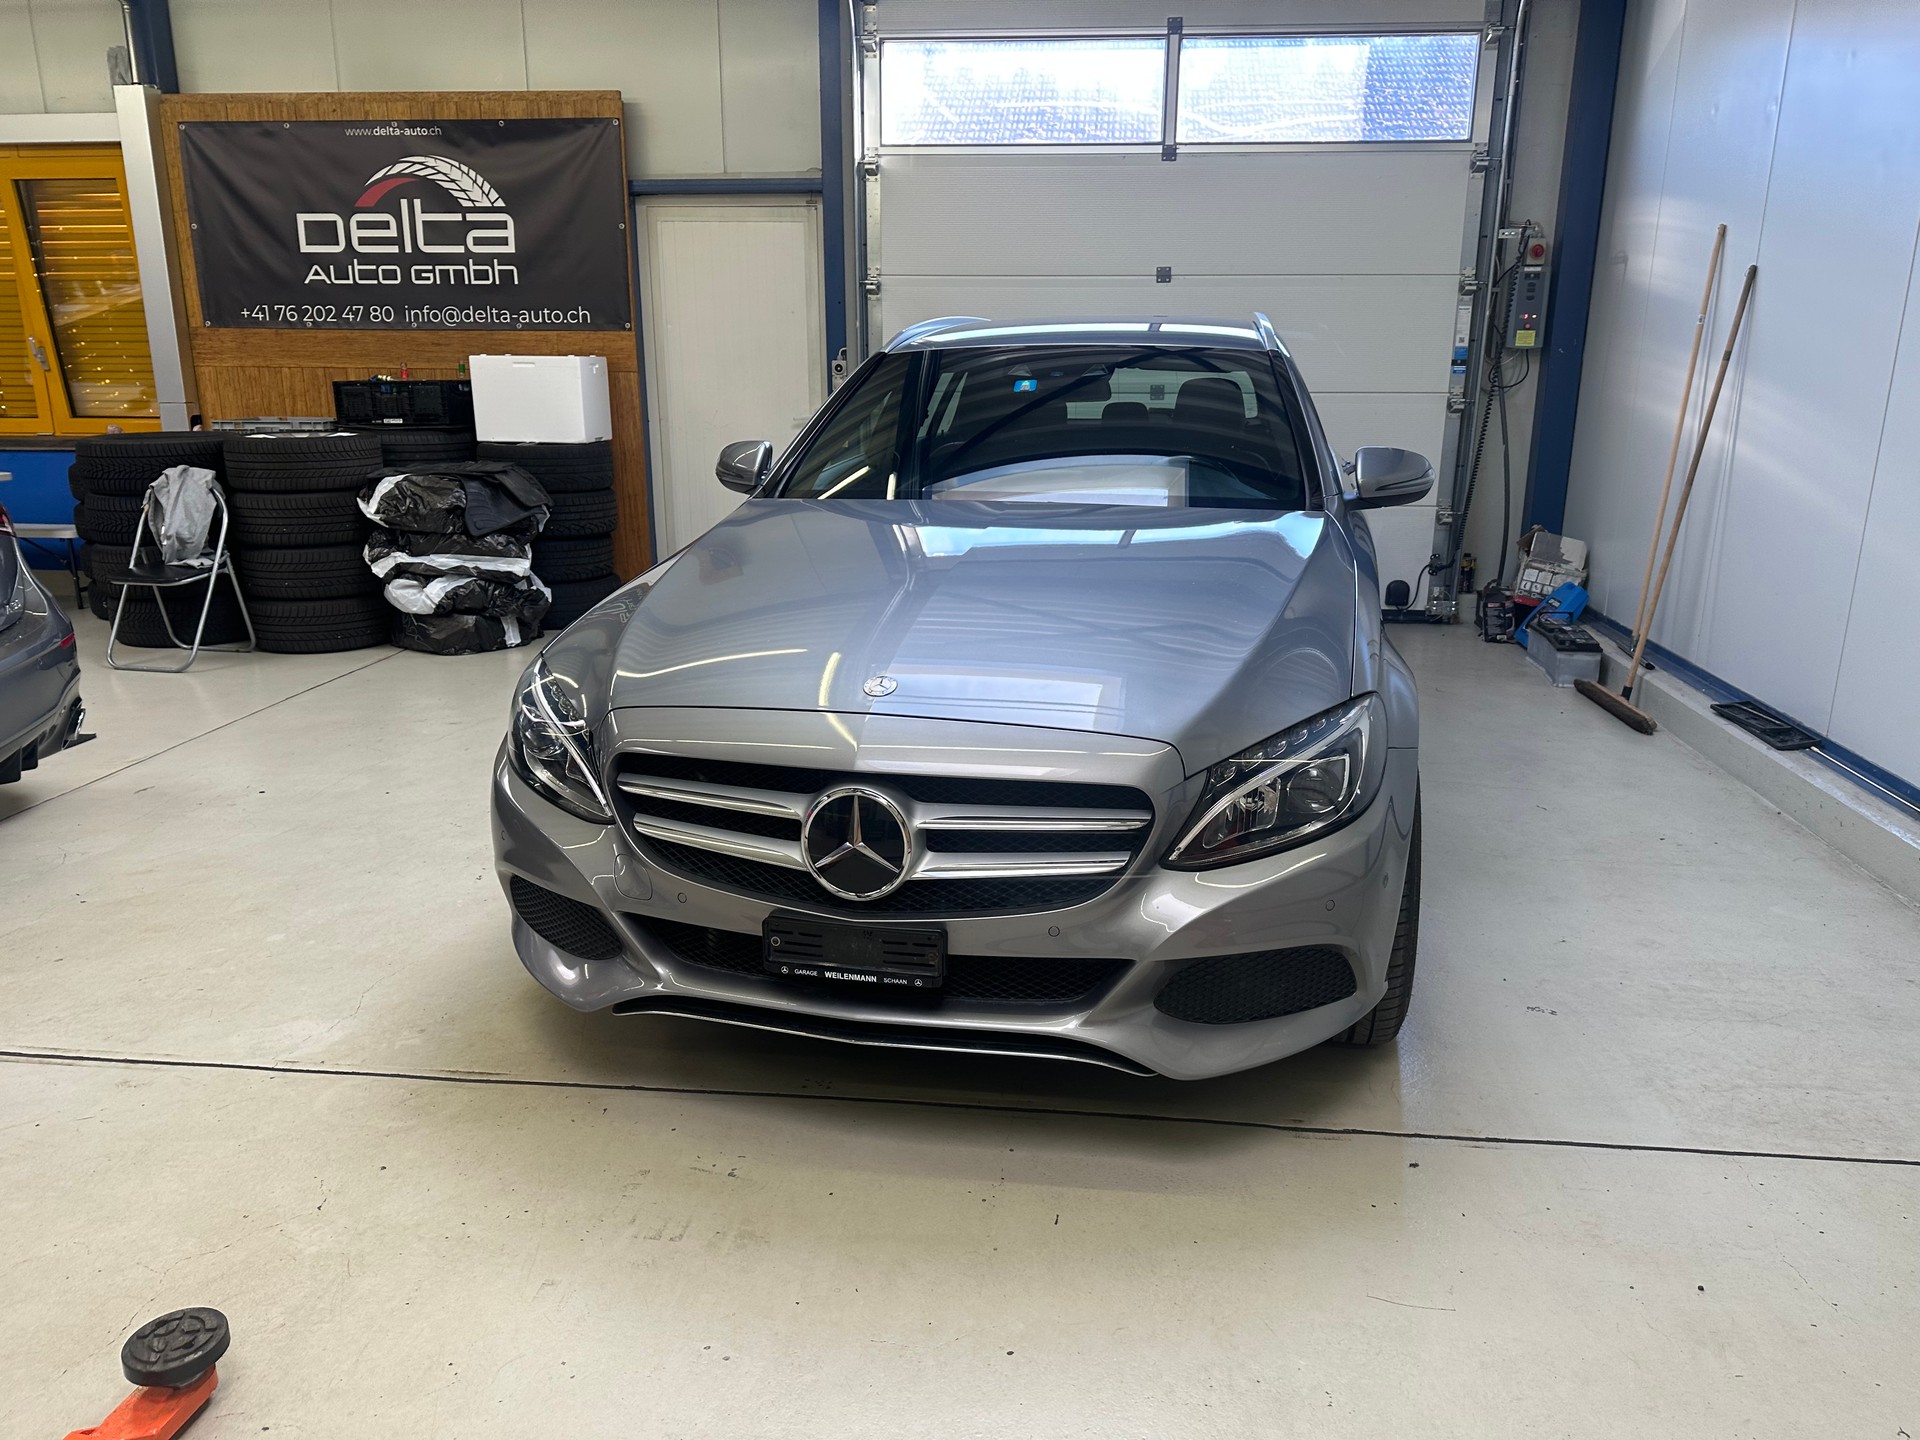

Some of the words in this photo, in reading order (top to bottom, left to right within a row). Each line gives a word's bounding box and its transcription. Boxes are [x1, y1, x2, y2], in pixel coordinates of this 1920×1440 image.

[344, 126, 442, 136] www.delta-auto.ch
[240, 305, 270, 321] +41
[274, 305, 298, 322] 76
[302, 305, 337, 322] 202
[341, 305, 364, 322] 47
[369, 305, 395, 322] 80
[404, 305, 592, 326] info@delta-auto.ch
[794, 968, 818, 977] GARAGE
[824, 971, 877, 982] WEILENMANN
[883, 977, 908, 985] SCHAAN
